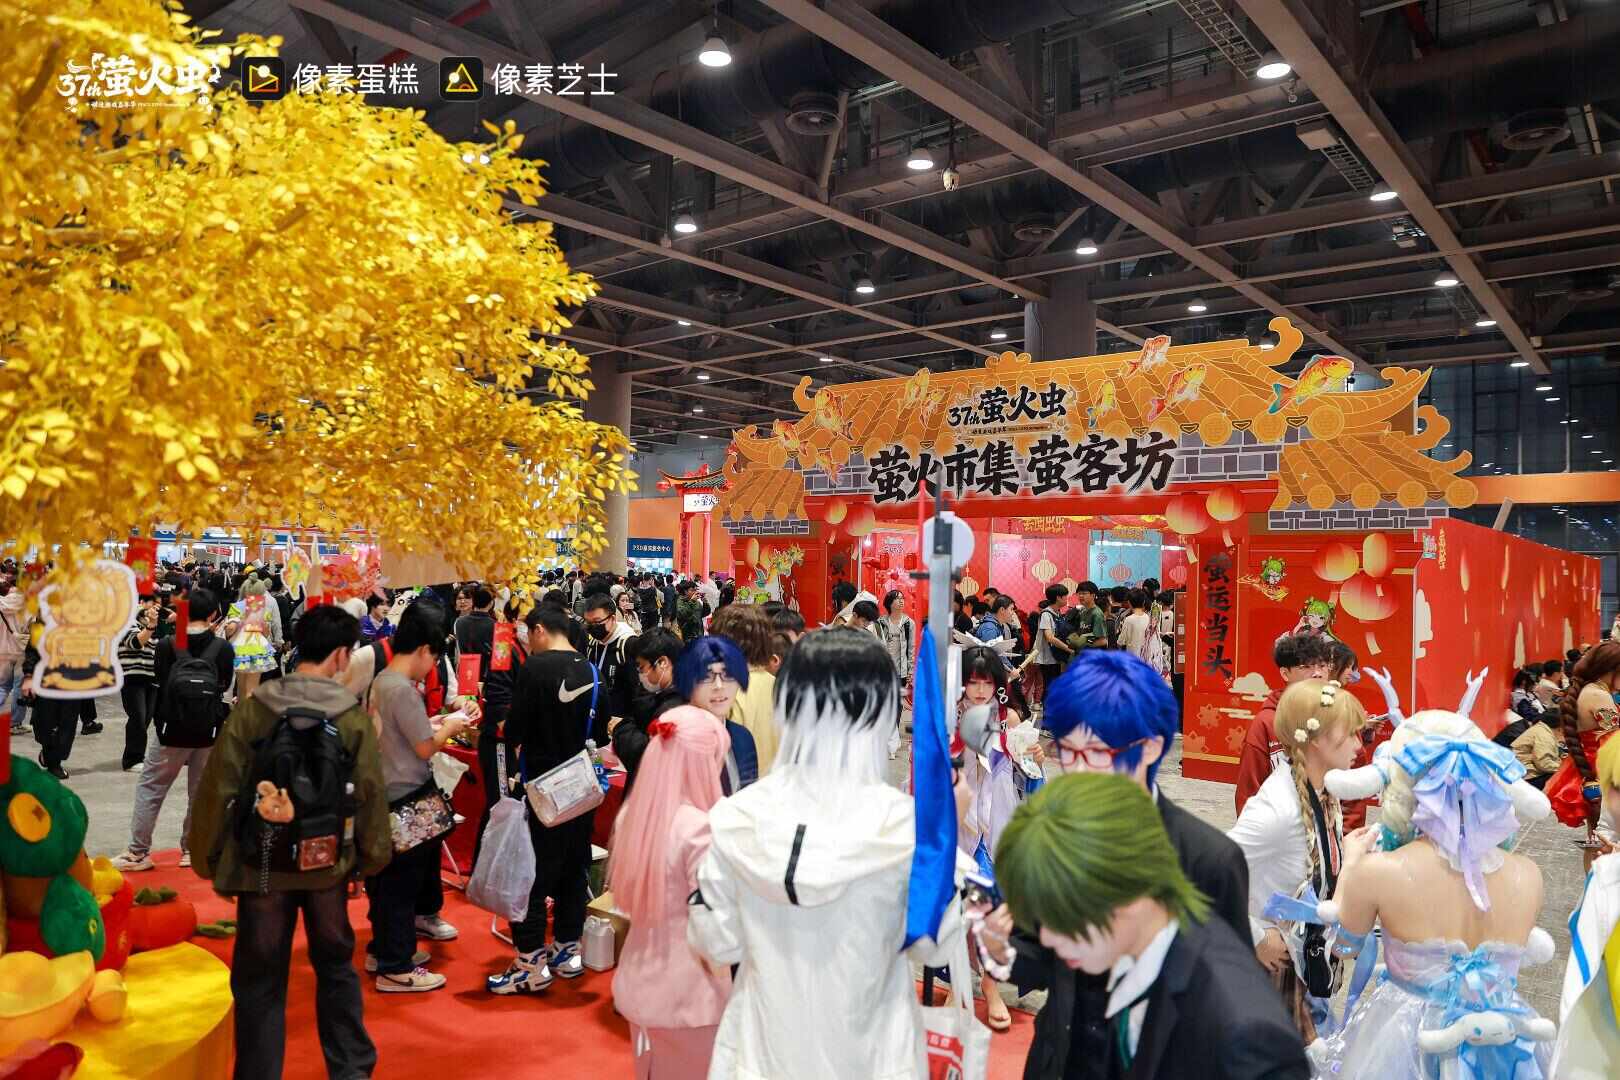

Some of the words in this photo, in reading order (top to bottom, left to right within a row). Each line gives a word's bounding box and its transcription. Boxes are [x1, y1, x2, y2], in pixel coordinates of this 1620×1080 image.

[947, 405, 981, 427] 37th
[978, 382, 1067, 424] 萤火虫
[868, 441, 1020, 503] 萤火市集
[1026, 431, 1177, 496] 萤客坊
[1203, 551, 1233, 678] 萤运当头
